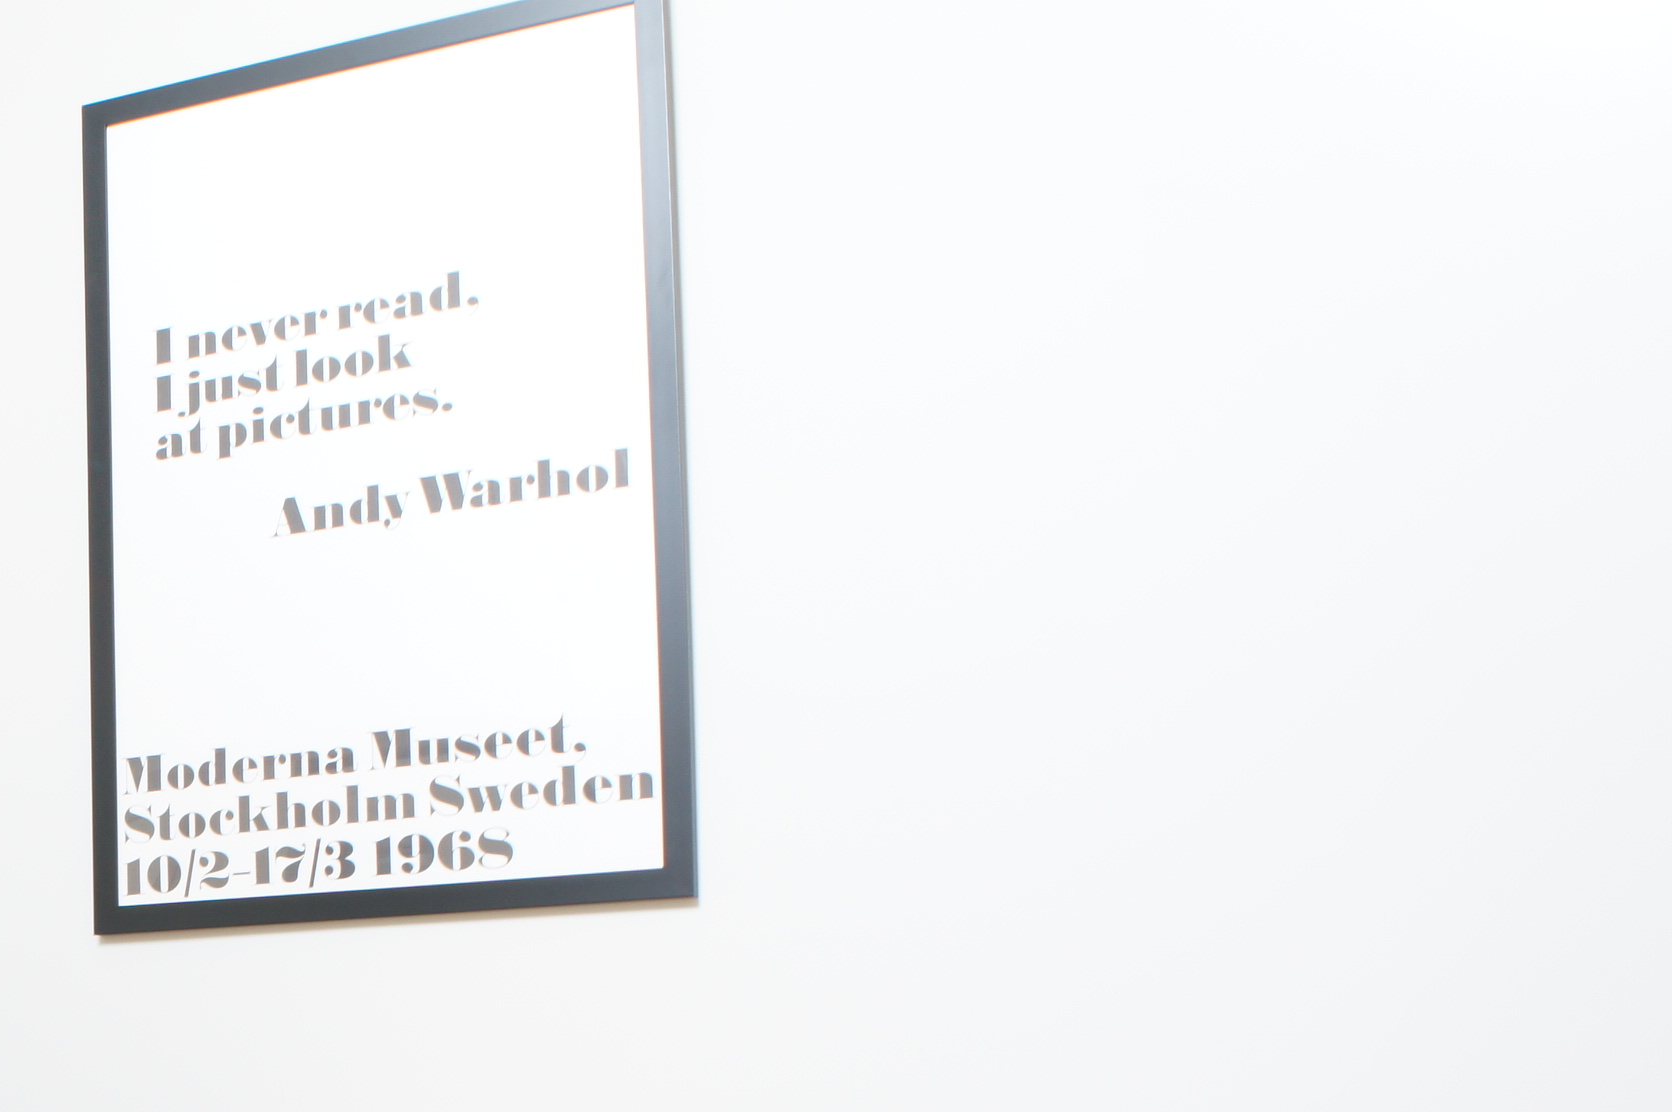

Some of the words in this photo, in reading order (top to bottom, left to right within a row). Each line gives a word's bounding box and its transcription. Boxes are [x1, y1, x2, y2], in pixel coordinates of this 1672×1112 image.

[155, 327, 174, 366] I
[187, 309, 329, 359] never
[337, 271, 480, 330] read,
[154, 373, 175, 413] I
[177, 355, 284, 418] just
[294, 334, 412, 387] look
[155, 420, 207, 461] at
[217, 384, 454, 460] pictures.
[271, 483, 410, 539] Andy
[419, 448, 630, 513] Warhol
[125, 747, 356, 793] Moderna
[370, 713, 587, 772] Museet,
[123, 784, 416, 843] Stockholm
[428, 765, 655, 815] Sweden
[374, 830, 515, 876] 1968
